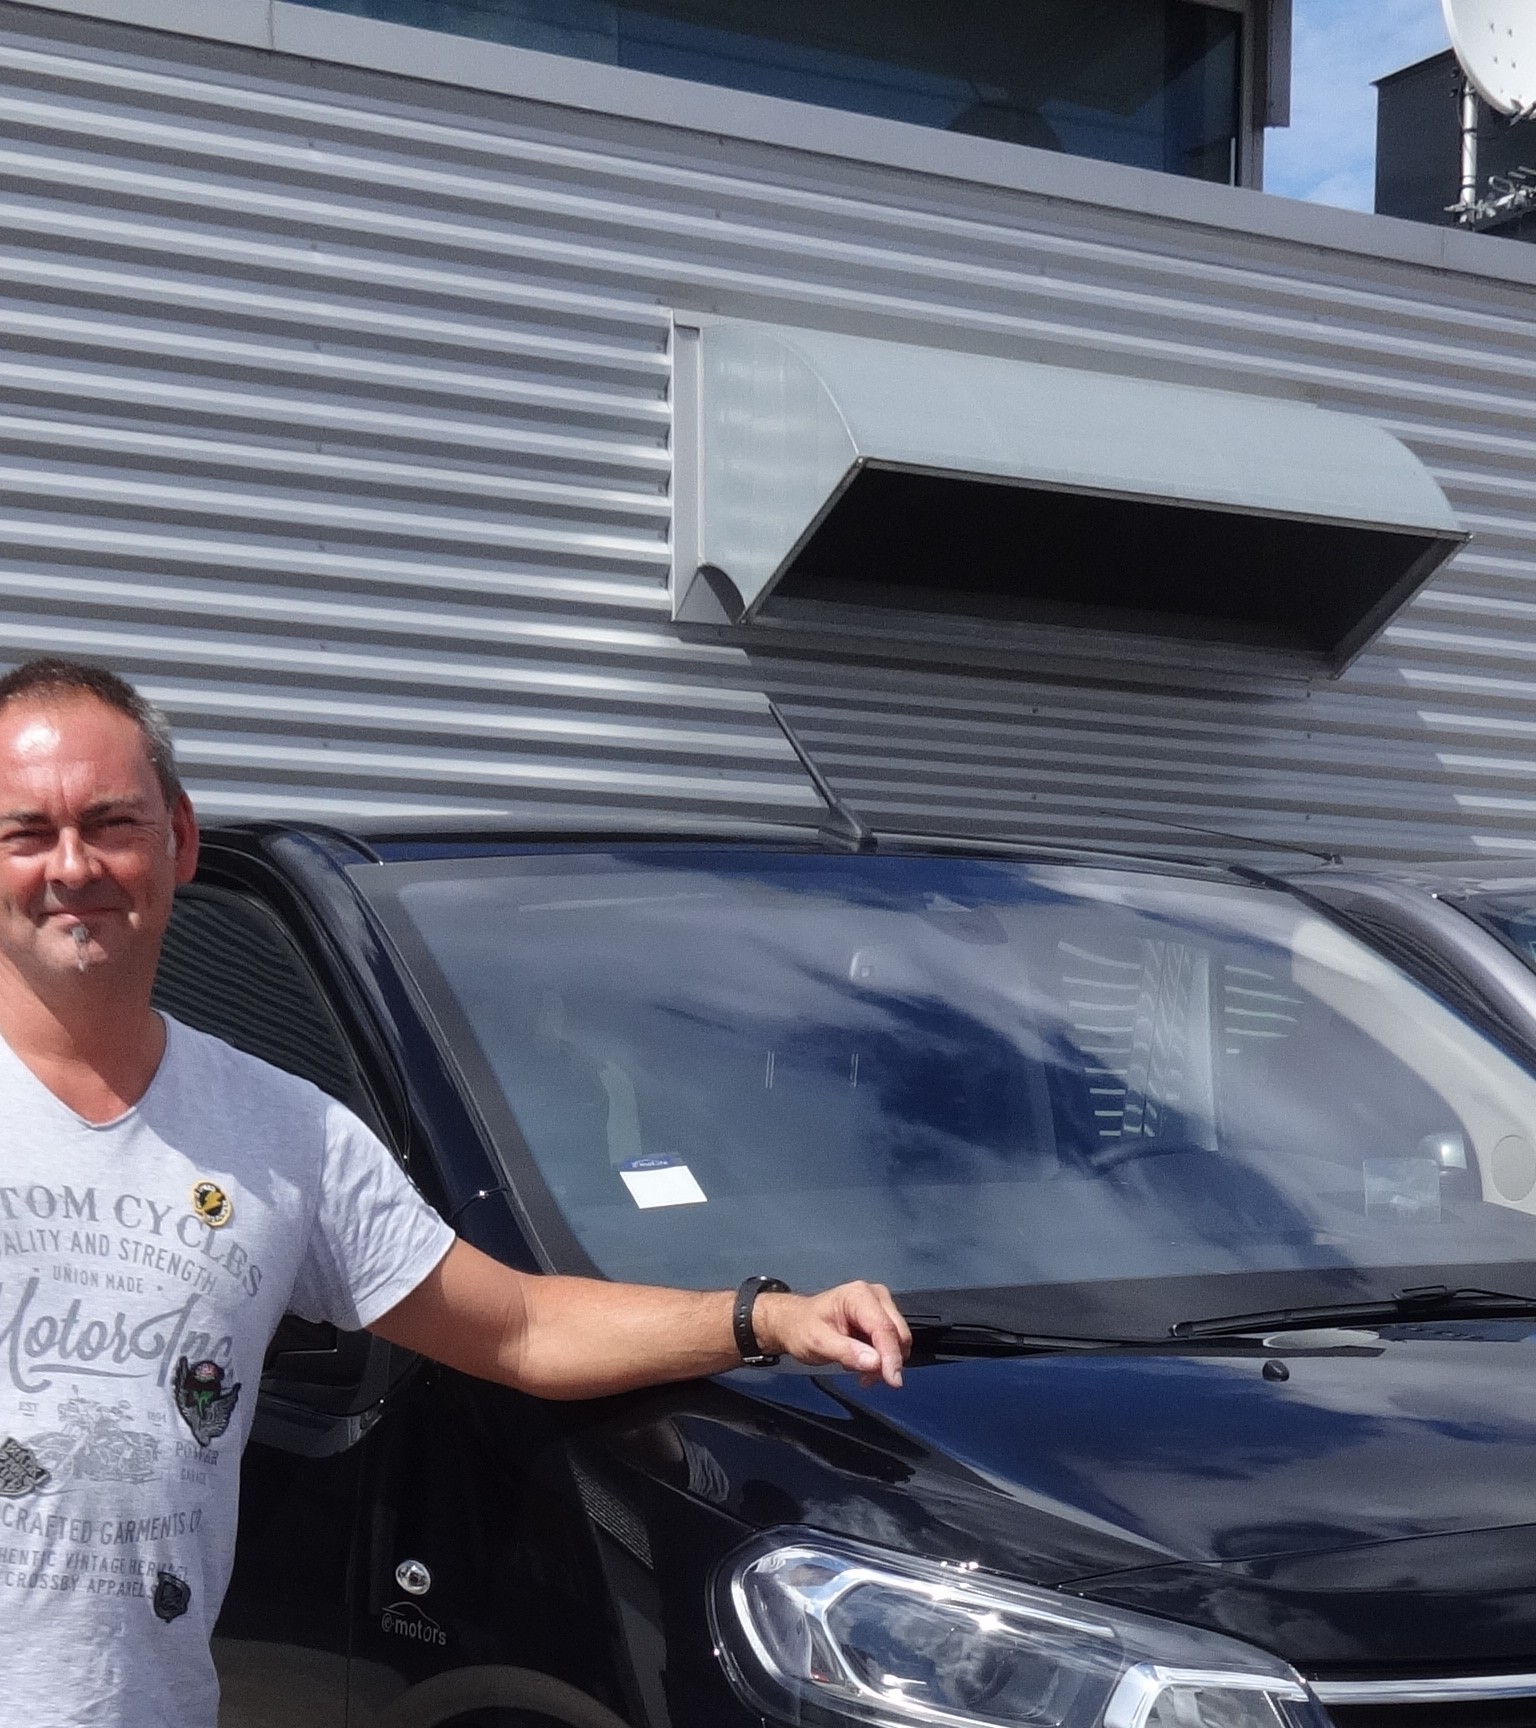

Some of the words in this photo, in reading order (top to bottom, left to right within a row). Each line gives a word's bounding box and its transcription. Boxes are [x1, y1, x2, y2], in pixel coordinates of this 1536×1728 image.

[113, 1193, 263, 1297] CYCLES
[52, 1265, 100, 1287] UNION
[105, 1271, 145, 1294] MADE
[71, 1230, 111, 1258] AND
[118, 1239, 219, 1297] STRENGTH
[100, 1512, 186, 1546] GARMENTS
[66, 1551, 126, 1575] VINTAGE
